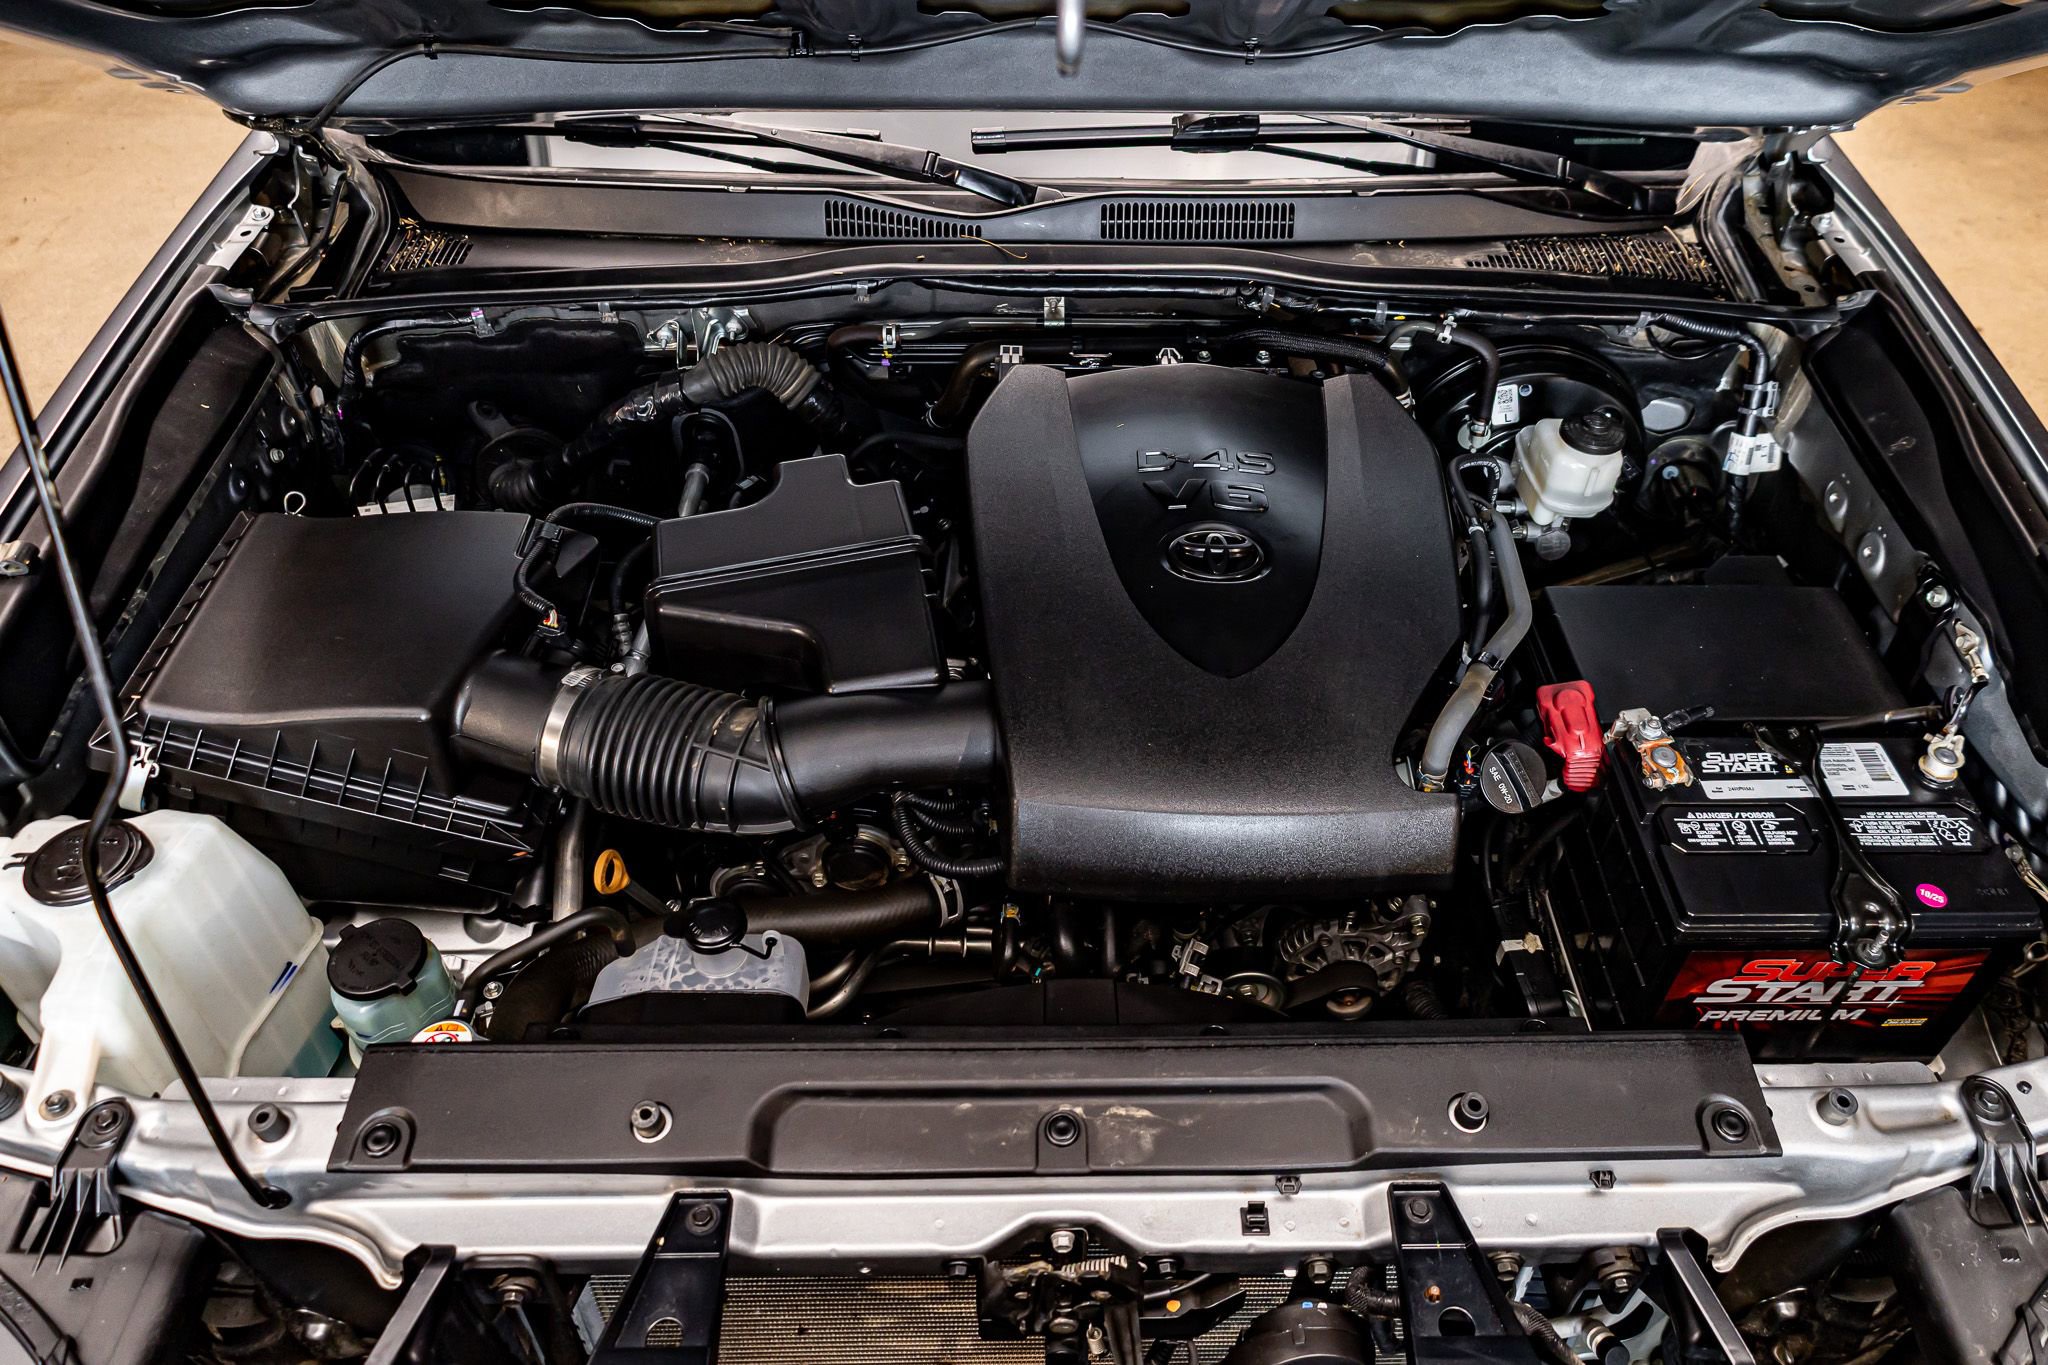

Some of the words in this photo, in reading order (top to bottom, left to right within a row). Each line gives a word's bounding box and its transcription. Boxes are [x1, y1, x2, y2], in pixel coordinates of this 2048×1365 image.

[1504, 413, 1512, 423] L
[1136, 447, 1276, 476] D-4S
[1142, 478, 1270, 513] V6
[1705, 752, 1773, 763] SUPER
[1489, 766, 1502, 782] SAE
[1701, 761, 1778, 774] START
[1498, 783, 1513, 804] 0W-20
[1919, 888, 1945, 904] 10/25
